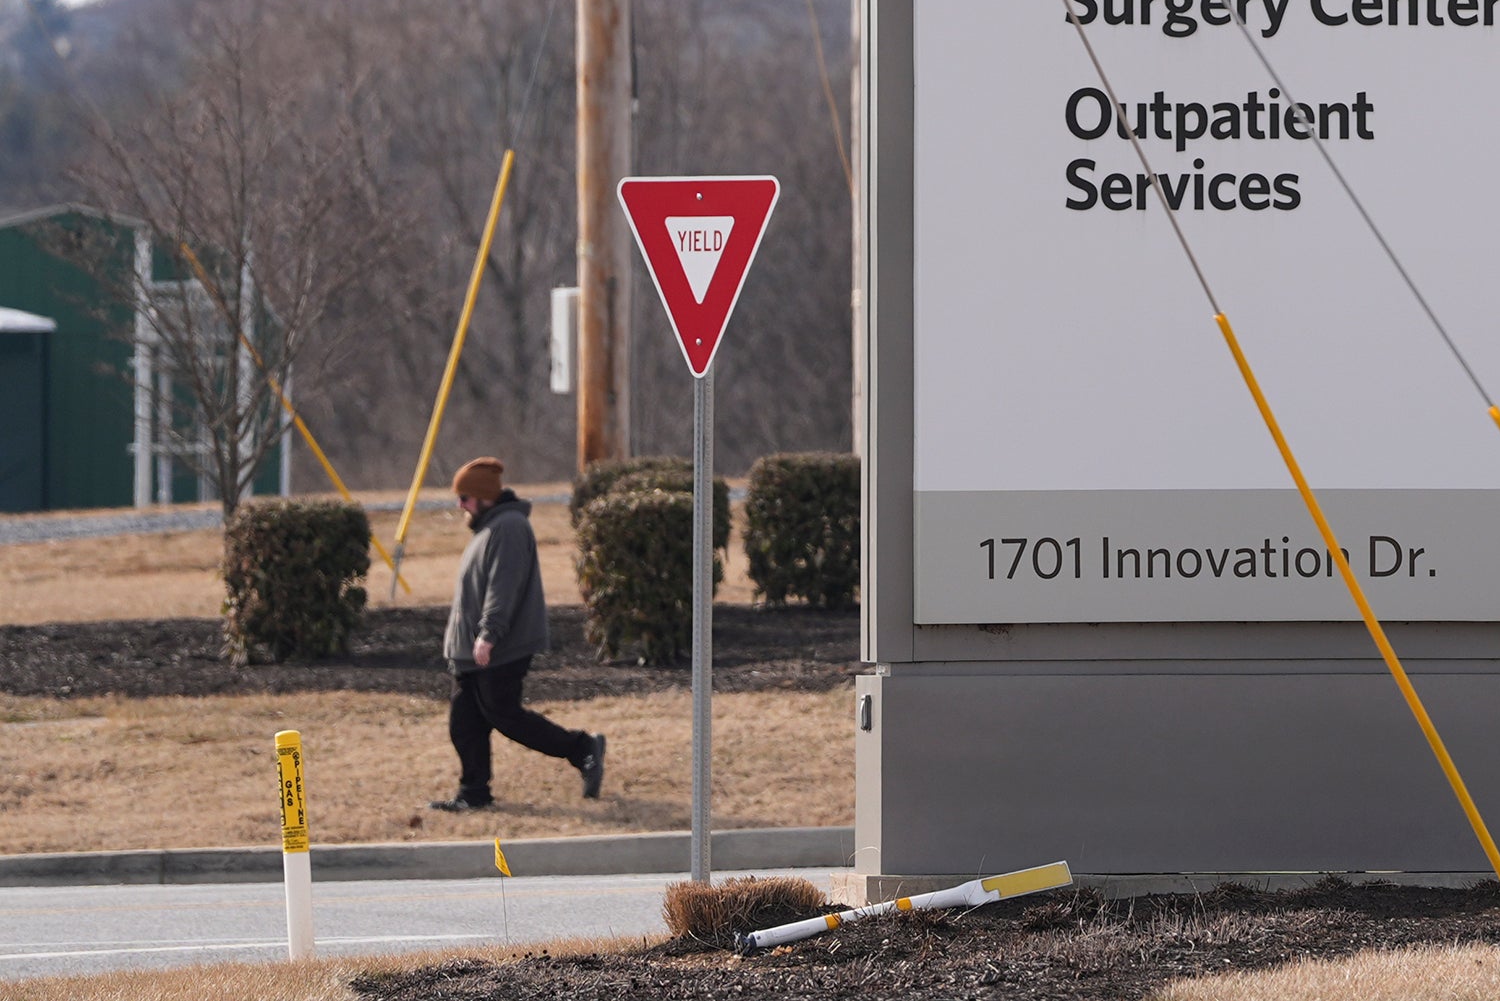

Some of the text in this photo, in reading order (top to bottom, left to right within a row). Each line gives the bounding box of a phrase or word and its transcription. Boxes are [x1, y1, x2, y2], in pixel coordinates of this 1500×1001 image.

[1066, 88, 1374, 152] Outpatient
[1066, 159, 1300, 210] Services
[677, 230, 723, 252] YIELD
[980, 536, 1435, 579] 1701 Innovation Dr.
[285, 780, 293, 806] GAS
[294, 760, 304, 825] PIPELINE
